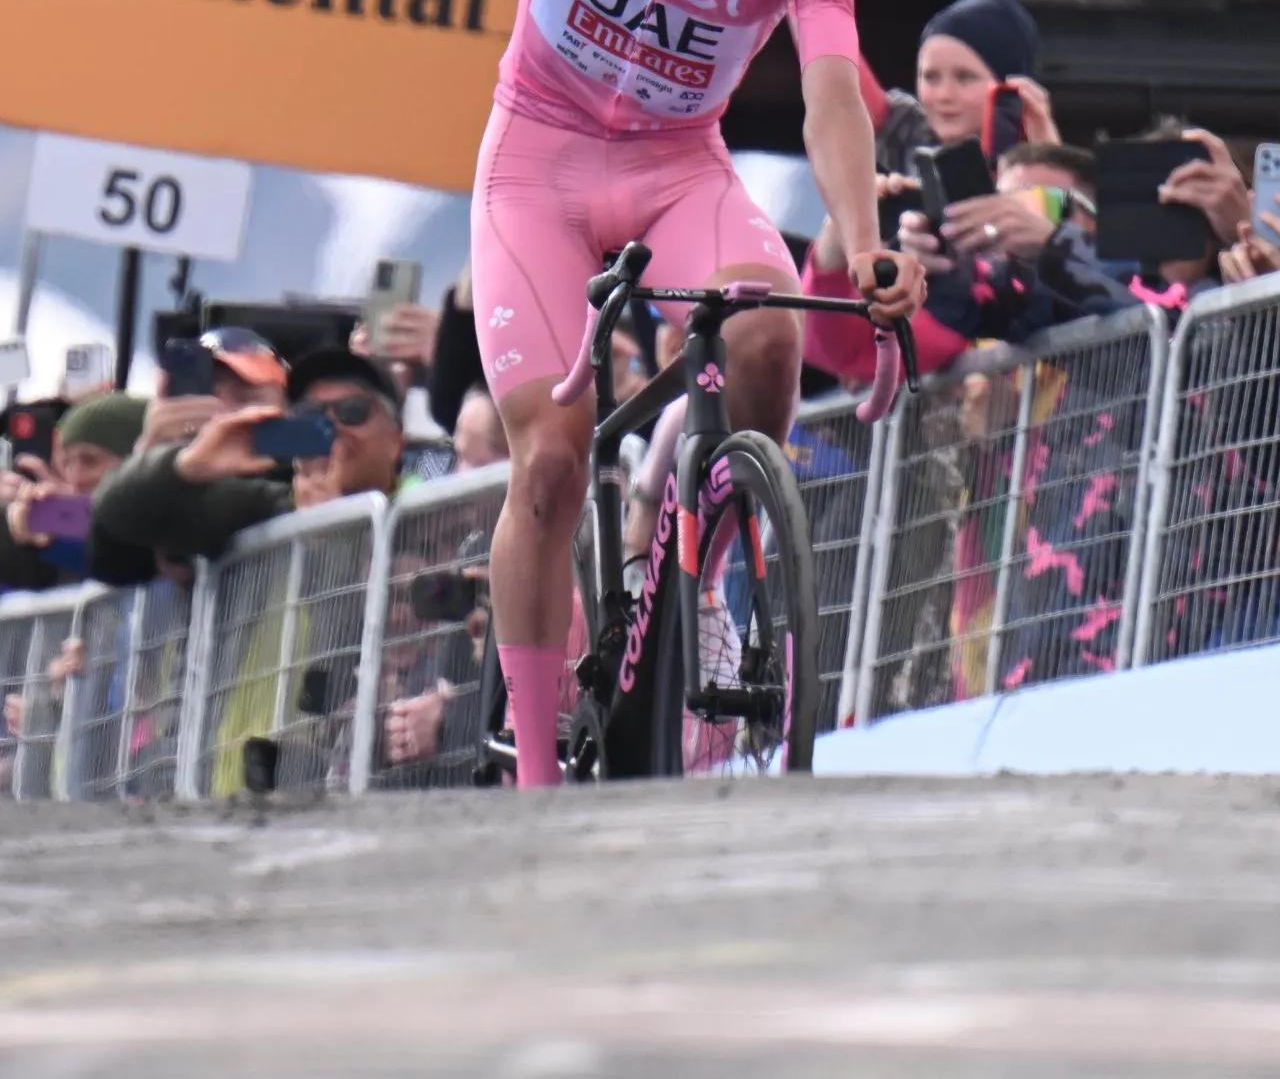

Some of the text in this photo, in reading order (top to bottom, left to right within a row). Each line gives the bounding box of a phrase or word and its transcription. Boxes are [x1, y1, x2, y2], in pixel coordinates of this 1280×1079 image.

[572, 1, 708, 87] Emirates
[99, 169, 184, 234] 50
[620, 472, 677, 693] COLNAGO
